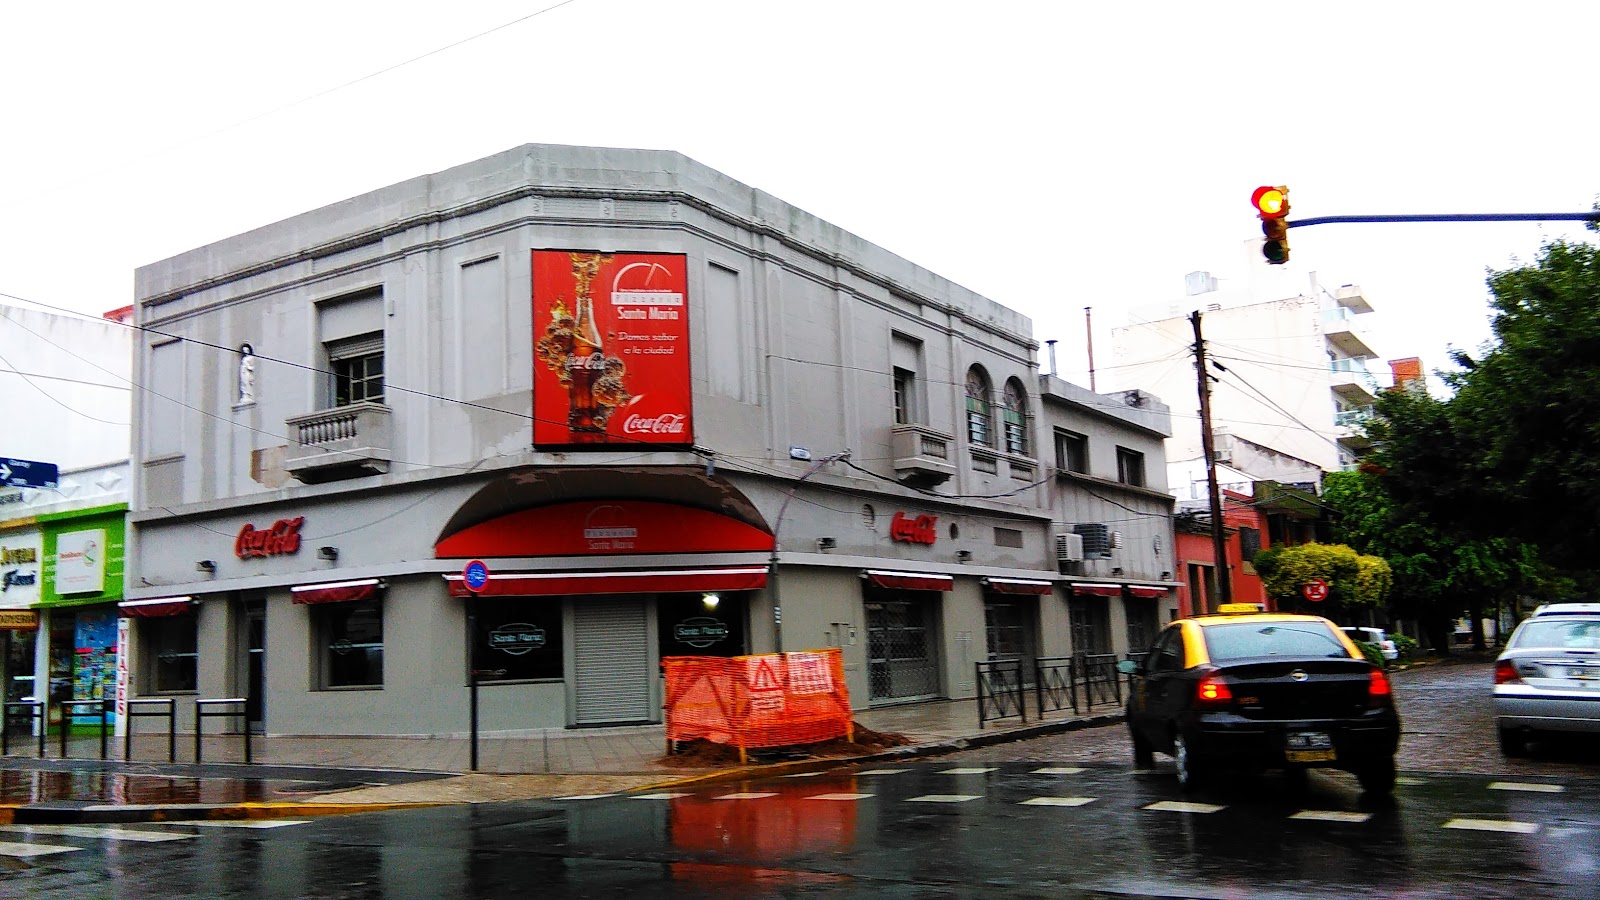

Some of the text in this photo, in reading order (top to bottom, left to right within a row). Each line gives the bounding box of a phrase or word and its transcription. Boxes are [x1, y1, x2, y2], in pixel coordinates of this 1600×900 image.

[617, 306, 647, 319] Santa
[632, 346, 641, 354] la
[643, 346, 674, 354] ciudad
